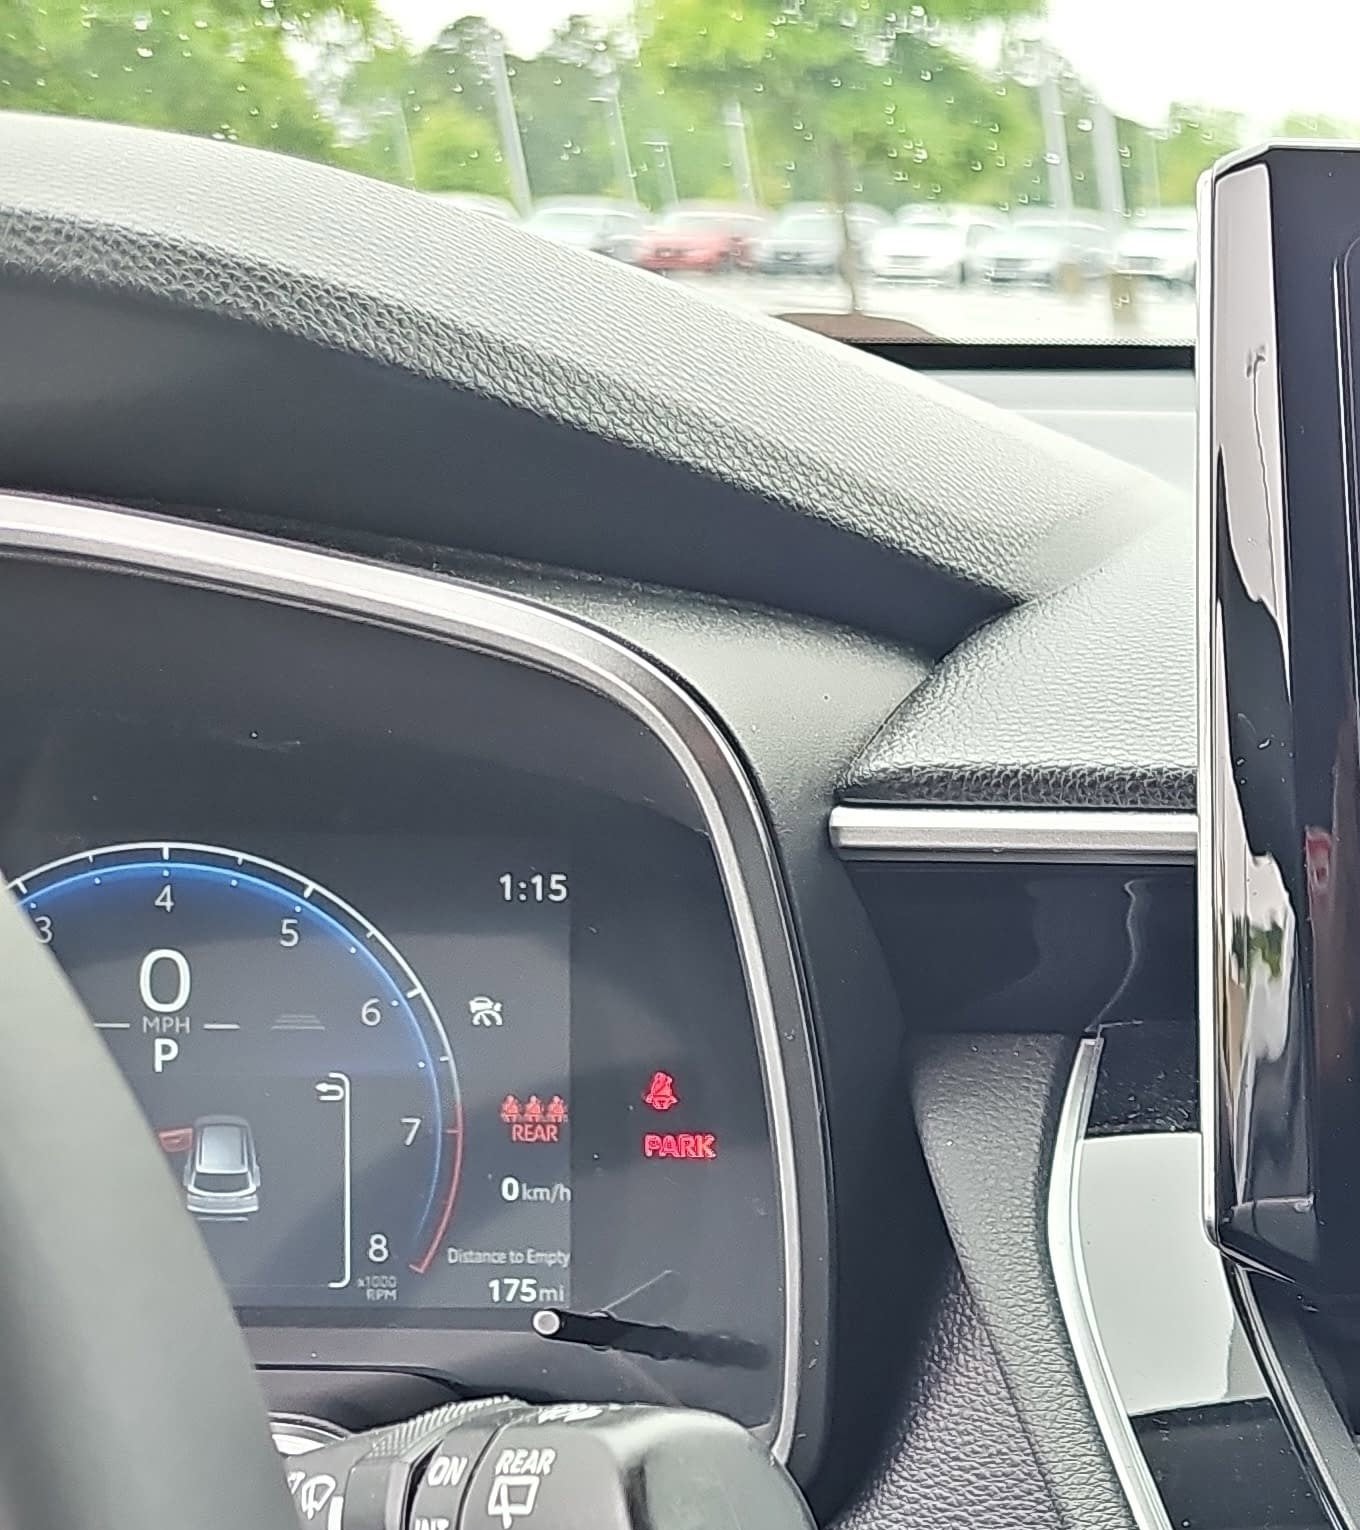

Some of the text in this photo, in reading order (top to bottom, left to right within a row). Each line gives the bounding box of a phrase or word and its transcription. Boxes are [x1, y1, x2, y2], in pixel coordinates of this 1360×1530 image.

[154, 884, 175, 913] 4
[498, 873, 570, 903] 1:15
[34, 915, 54, 944] 3
[279, 918, 300, 947] 5
[139, 948, 192, 1013] 0
[142, 1016, 191, 1034] MPH
[360, 998, 383, 1028] 6
[154, 1038, 178, 1073] P
[402, 1117, 422, 1147] 7
[512, 1123, 558, 1142] REAR
[644, 1133, 717, 1159] PARK
[368, 1234, 389, 1263] 8
[447, 1248, 571, 1268] Distance to Empty
[366, 1289, 397, 1301] RPM
[428, 1456, 468, 1486] ON
[495, 1448, 556, 1475] REAR
